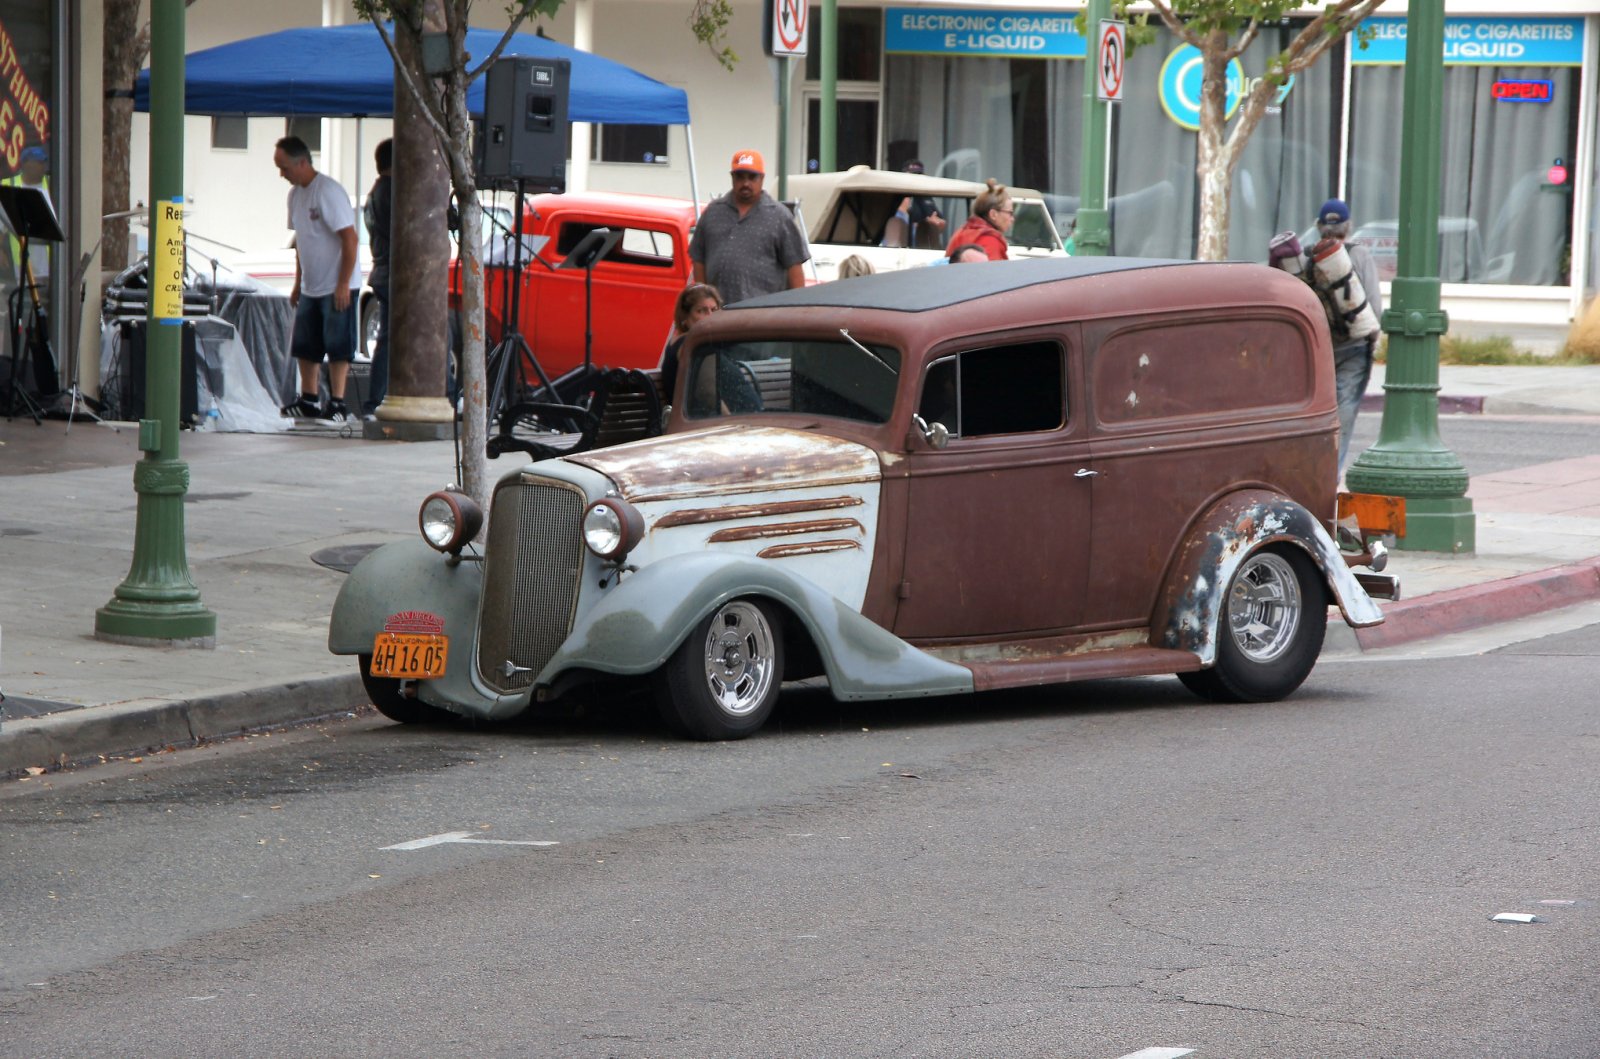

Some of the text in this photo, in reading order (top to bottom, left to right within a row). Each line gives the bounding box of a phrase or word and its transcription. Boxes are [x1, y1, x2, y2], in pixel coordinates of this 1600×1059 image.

[902, 14, 1080, 33] ELECTRONIC CIGARETTE
[1475, 24, 1574, 41] CIGARETTES
[945, 33, 1046, 50] E-LIQUID
[1491, 81, 1549, 99] OPEN
